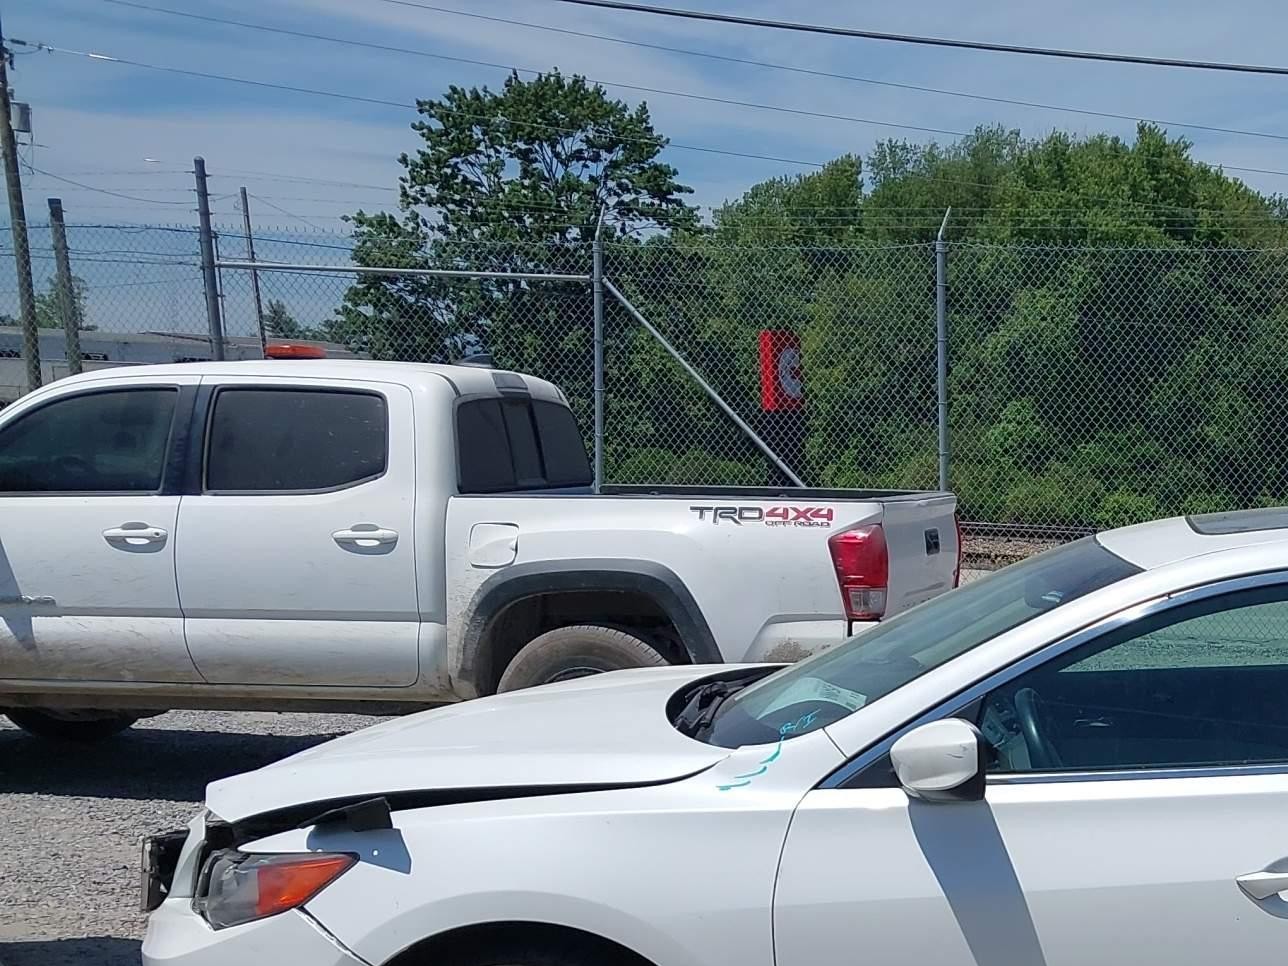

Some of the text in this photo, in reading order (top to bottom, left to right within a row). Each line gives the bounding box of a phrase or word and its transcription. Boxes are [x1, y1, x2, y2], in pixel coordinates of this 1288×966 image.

[689, 505, 763, 526] TRD
[764, 520, 831, 528] OFF ROAD
